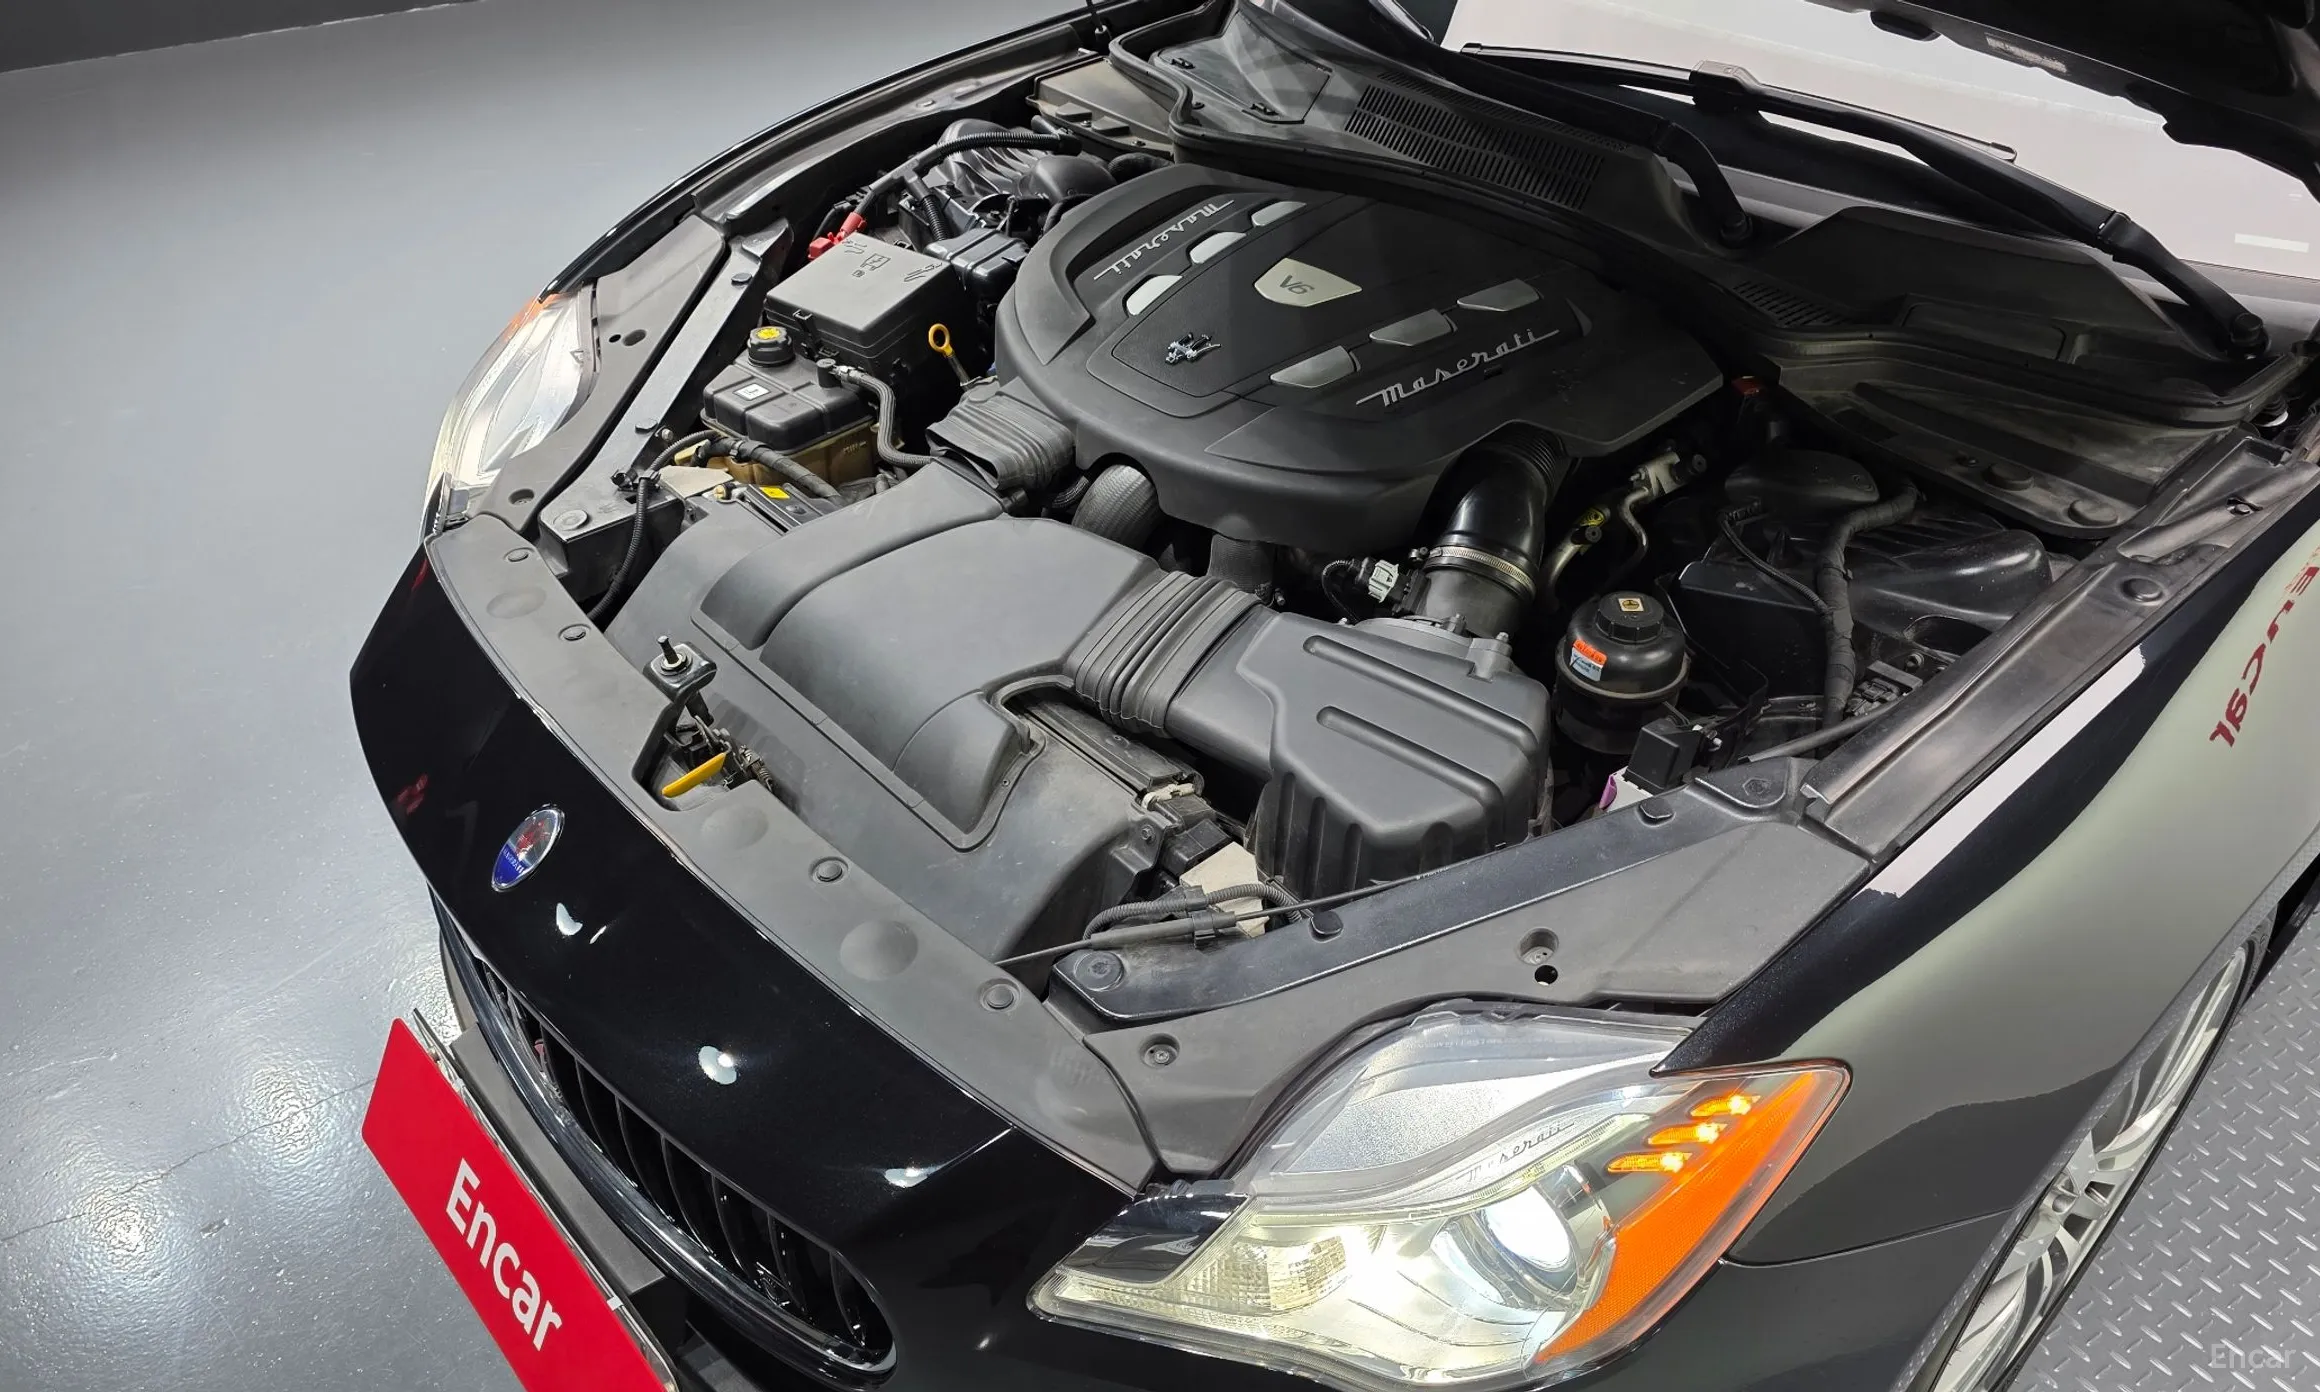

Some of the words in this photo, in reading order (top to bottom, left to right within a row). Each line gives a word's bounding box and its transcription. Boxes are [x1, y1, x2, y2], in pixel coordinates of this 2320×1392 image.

[1093, 199, 1235, 281] Maserati
[1279, 274, 1315, 295] V6
[1356, 328, 1560, 407] Maserati
[445, 1158, 563, 1352] Encar
